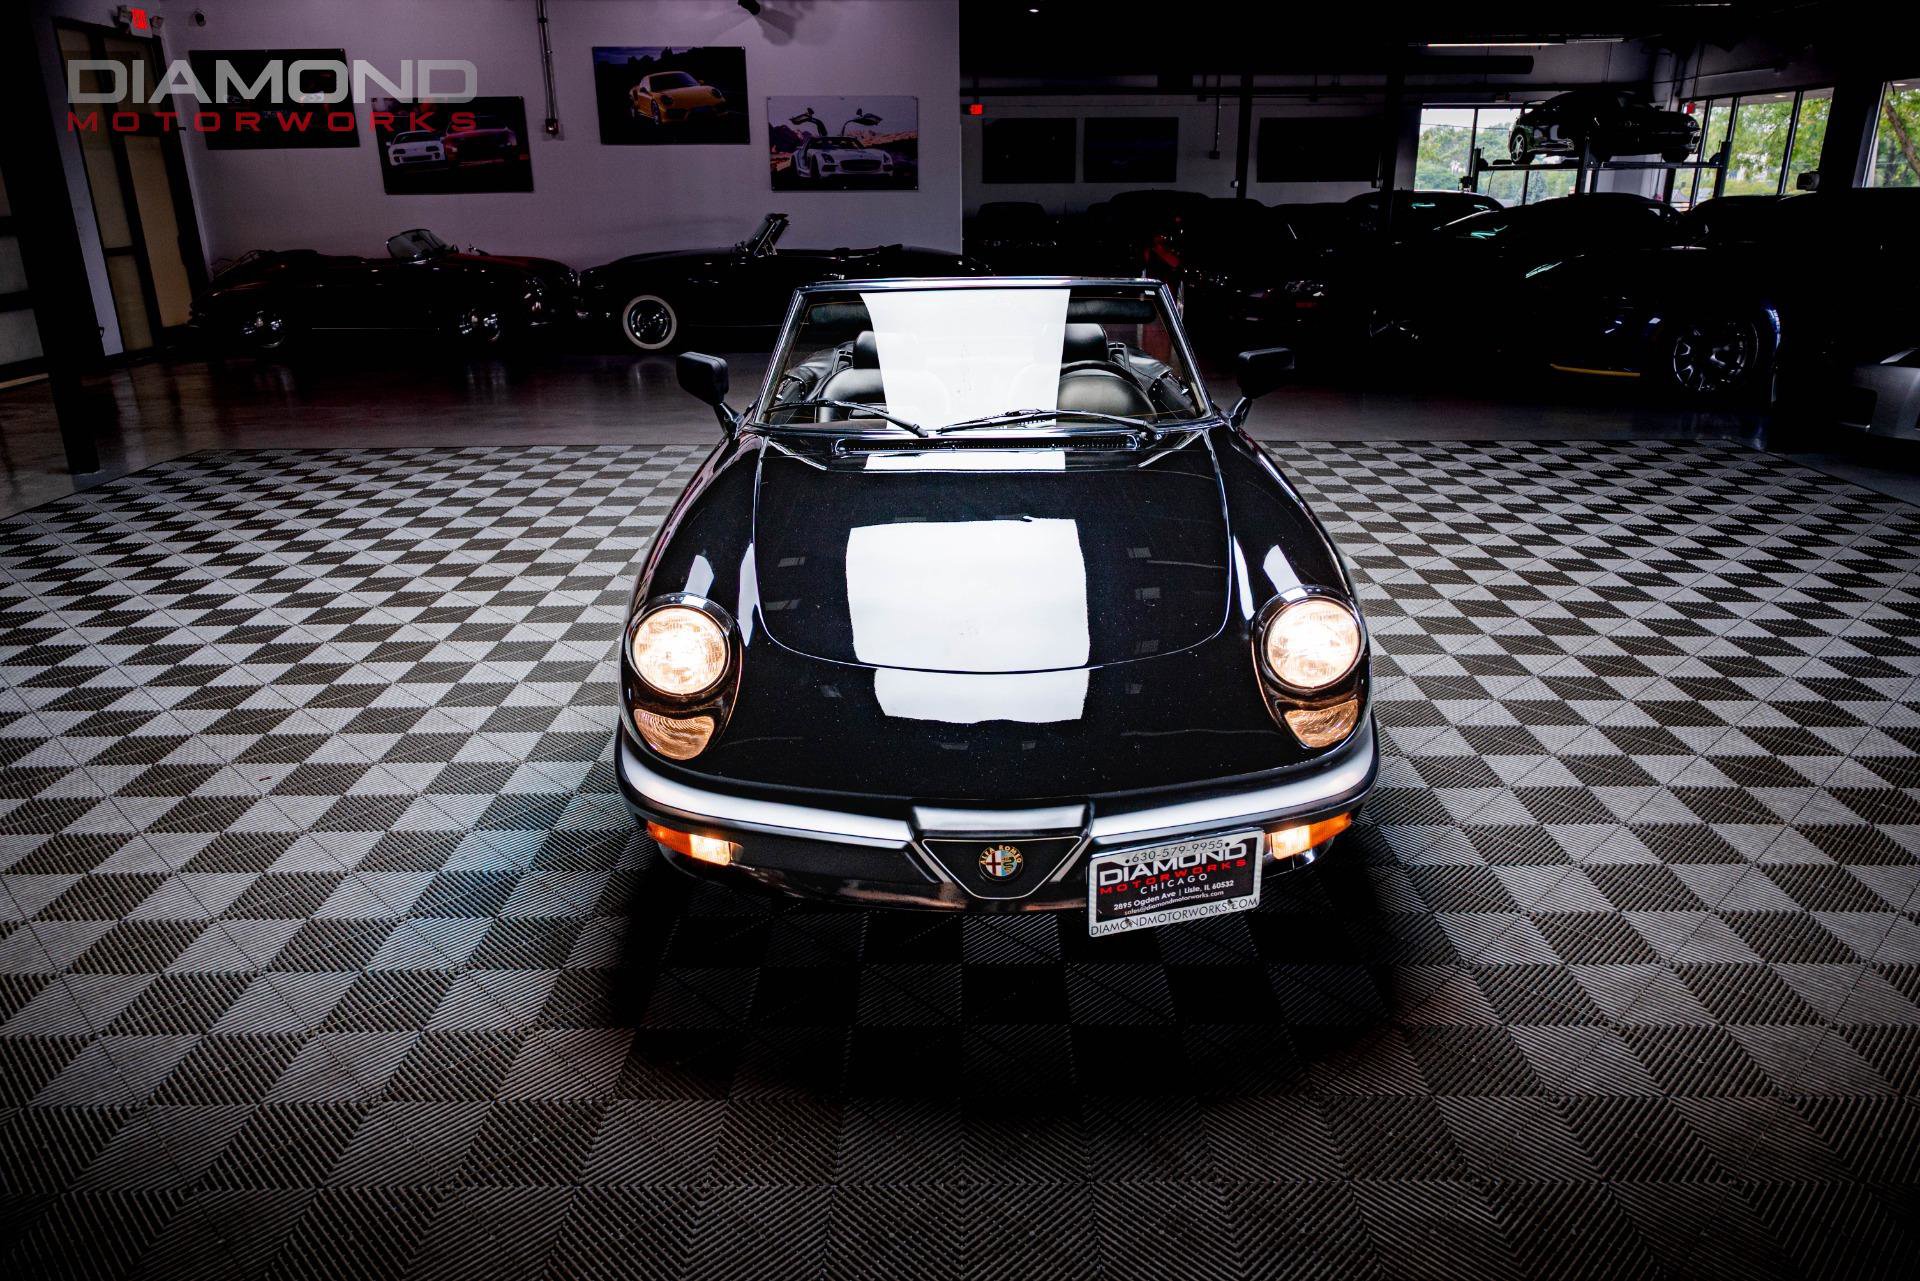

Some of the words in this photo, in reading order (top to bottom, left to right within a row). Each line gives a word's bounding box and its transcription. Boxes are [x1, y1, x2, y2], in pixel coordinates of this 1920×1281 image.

[1099, 842, 1247, 886] DIAMOND
[1131, 839, 1223, 863] 630-579-9955
[1099, 859, 1248, 895] MOTORWORKS
[1140, 873, 1208, 895] CHICAGO
[1113, 901, 1132, 911] 2895
[1133, 896, 1160, 907] Ogden
[1161, 891, 1176, 900] Ave
[1212, 880, 1234, 890] 60532
